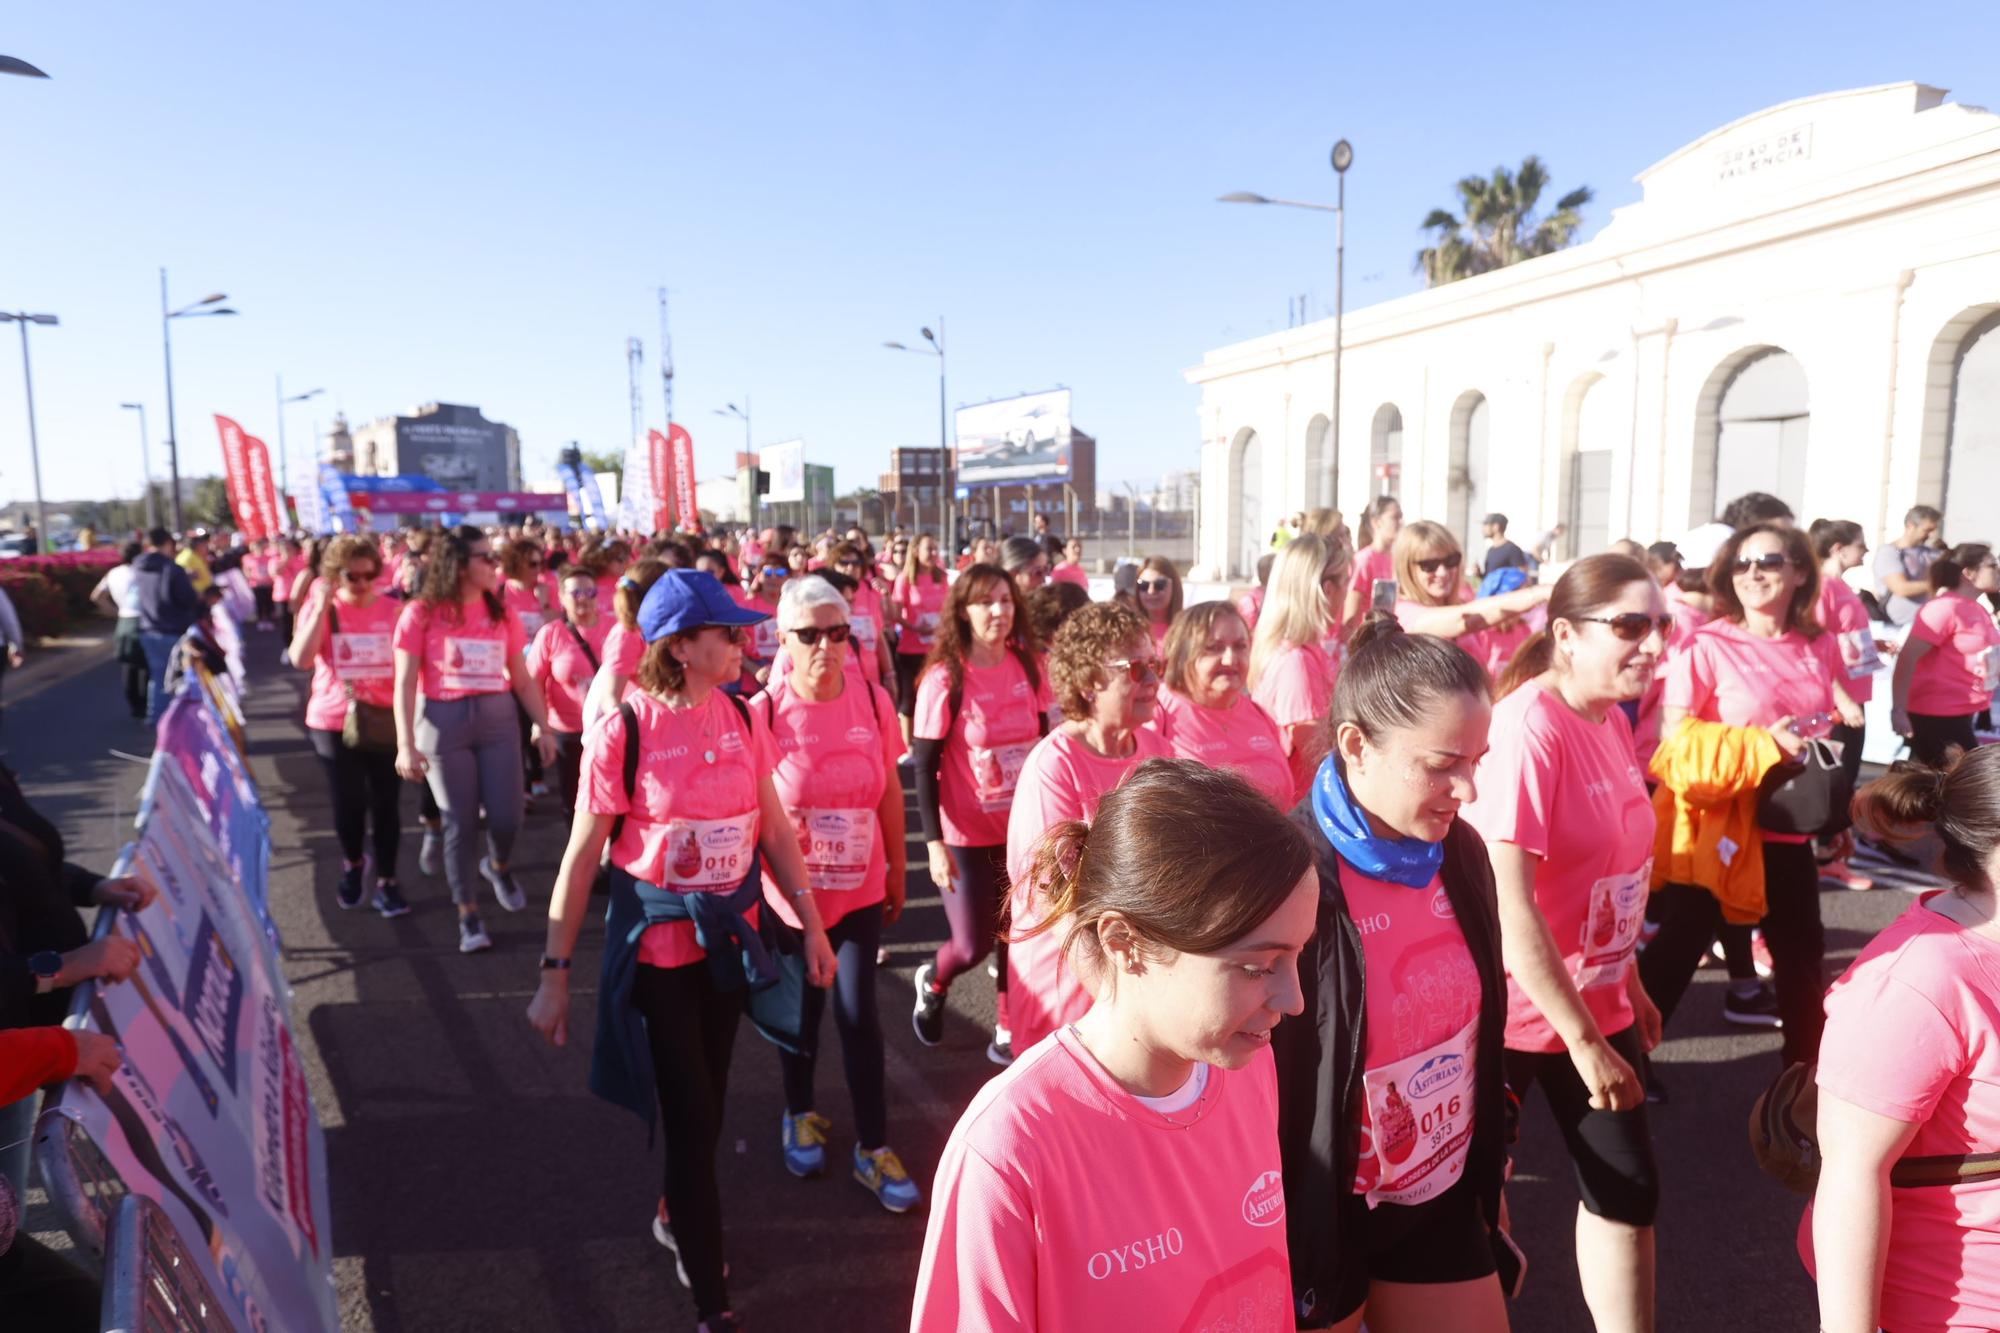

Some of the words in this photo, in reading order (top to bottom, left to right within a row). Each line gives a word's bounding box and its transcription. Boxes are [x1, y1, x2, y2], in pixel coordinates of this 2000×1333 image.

[1778, 132, 1801, 148] DE
[1720, 146, 1803, 178] VALENCIA
[704, 853, 738, 871] 016
[814, 840, 845, 854] 016
[1413, 1063, 1464, 1096] ASTURIANA
[1420, 1094, 1461, 1135] 016
[1430, 1122, 1453, 1150] 3973
[1087, 1226, 1184, 1281] OYSHO
